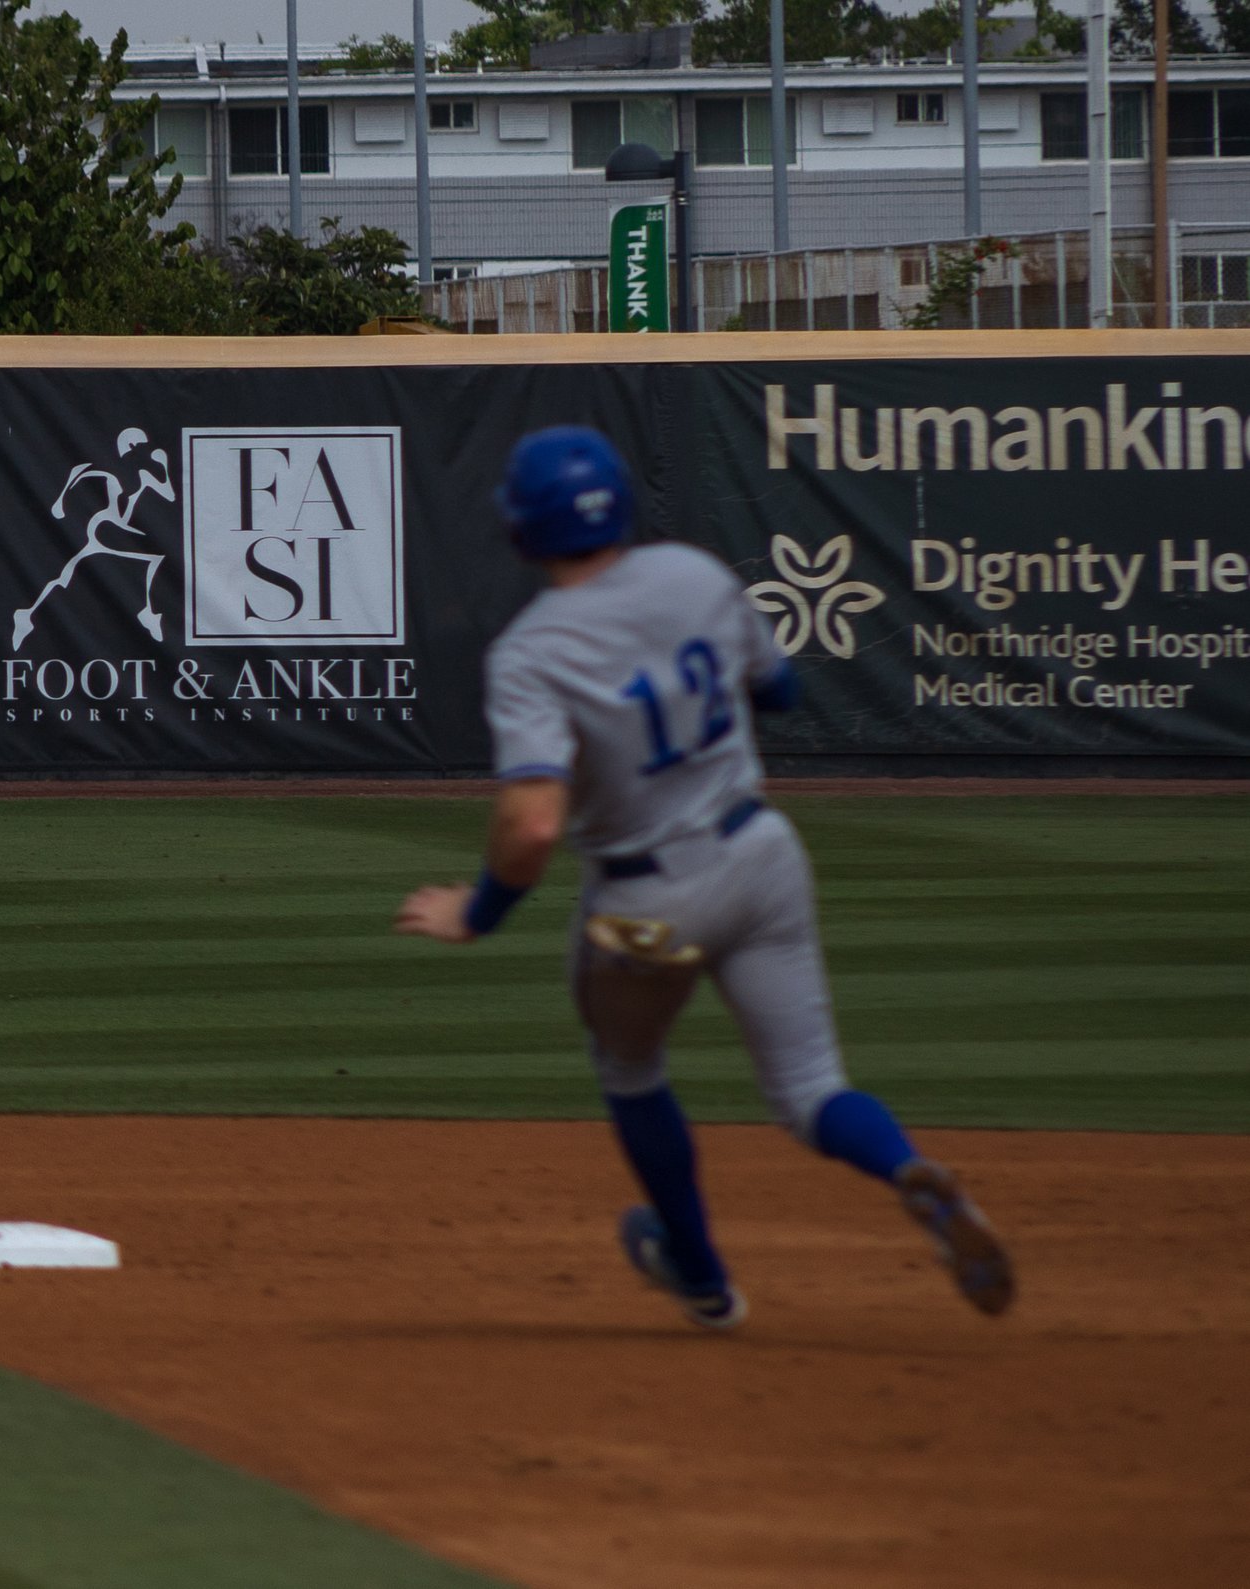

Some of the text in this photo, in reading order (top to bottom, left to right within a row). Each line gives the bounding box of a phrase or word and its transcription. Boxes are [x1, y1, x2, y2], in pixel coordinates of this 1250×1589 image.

[627, 225, 649, 319] THANK
[765, 382, 1250, 471] Humankin
[911, 538, 1250, 611] Dignity He
[913, 623, 1250, 668] Northridge Hospit
[2, 658, 417, 701] FOOT & ANKLE
[621, 637, 734, 776] 12
[915, 674, 1193, 709] Medical Center
[6, 707, 414, 723] SPORTS INSTITUTE
